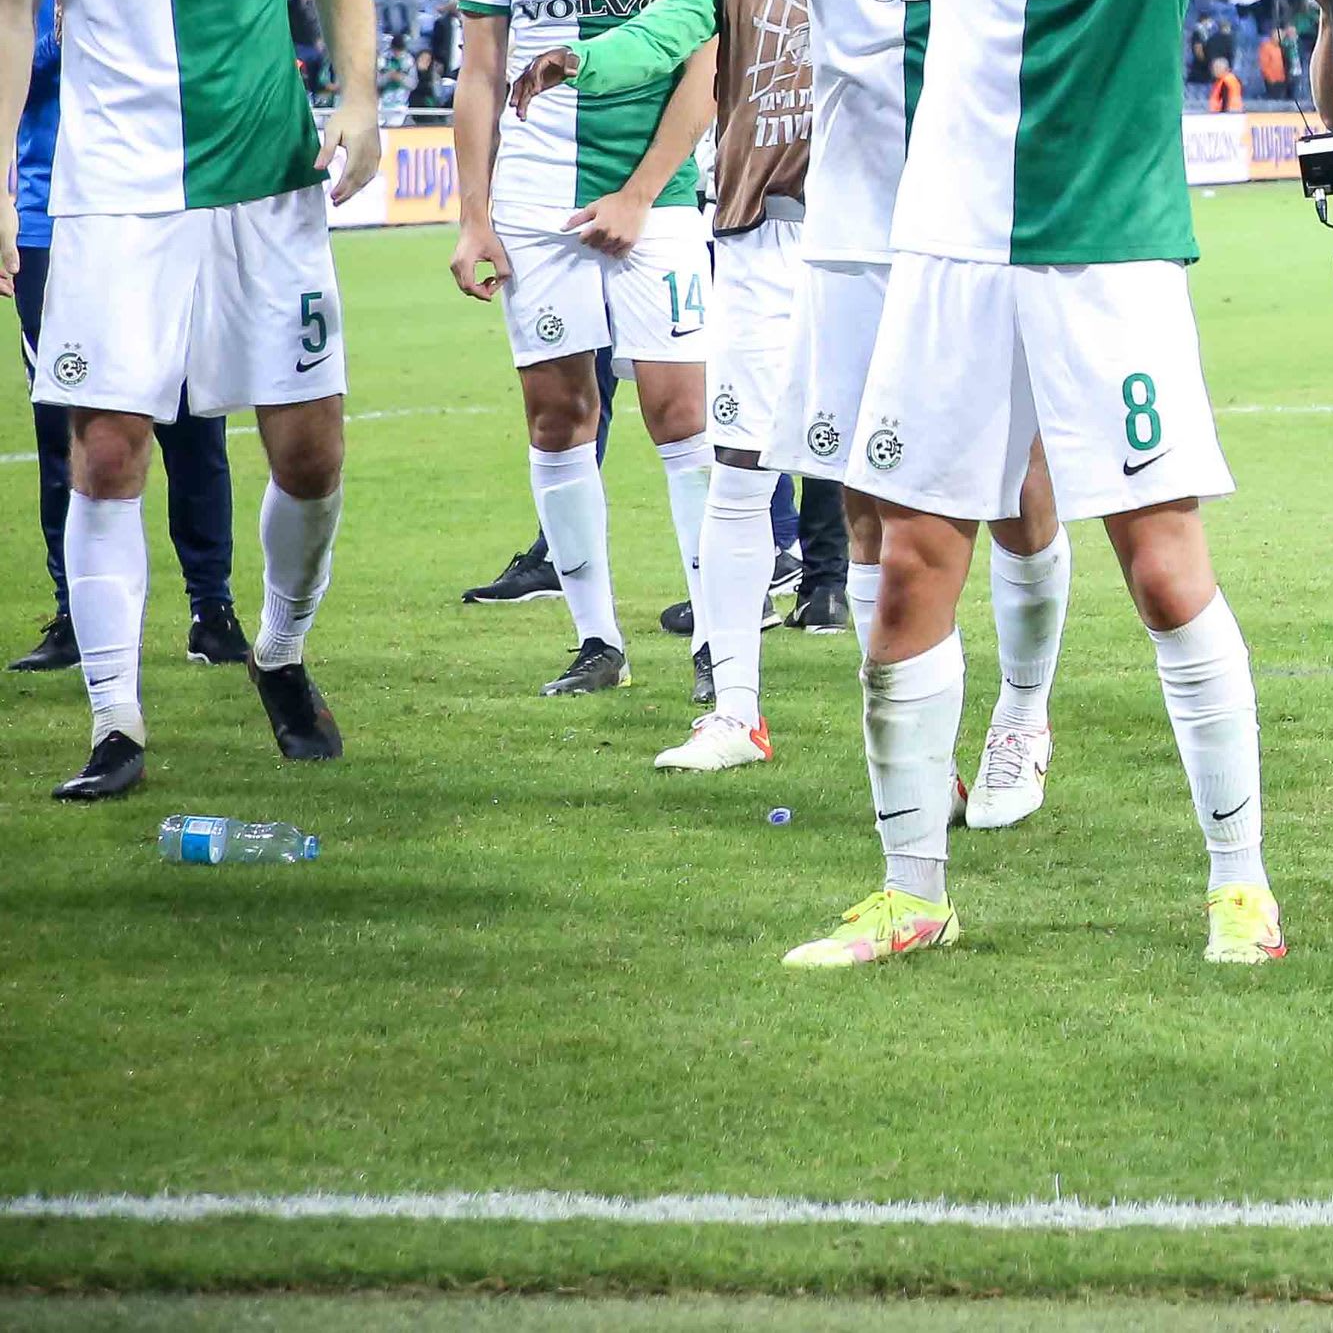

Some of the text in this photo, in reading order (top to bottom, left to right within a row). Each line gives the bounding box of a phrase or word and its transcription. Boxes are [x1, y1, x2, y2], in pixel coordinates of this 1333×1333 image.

[300, 292, 327, 353] 5
[662, 270, 705, 324] 14
[1122, 372, 1161, 451] 8
